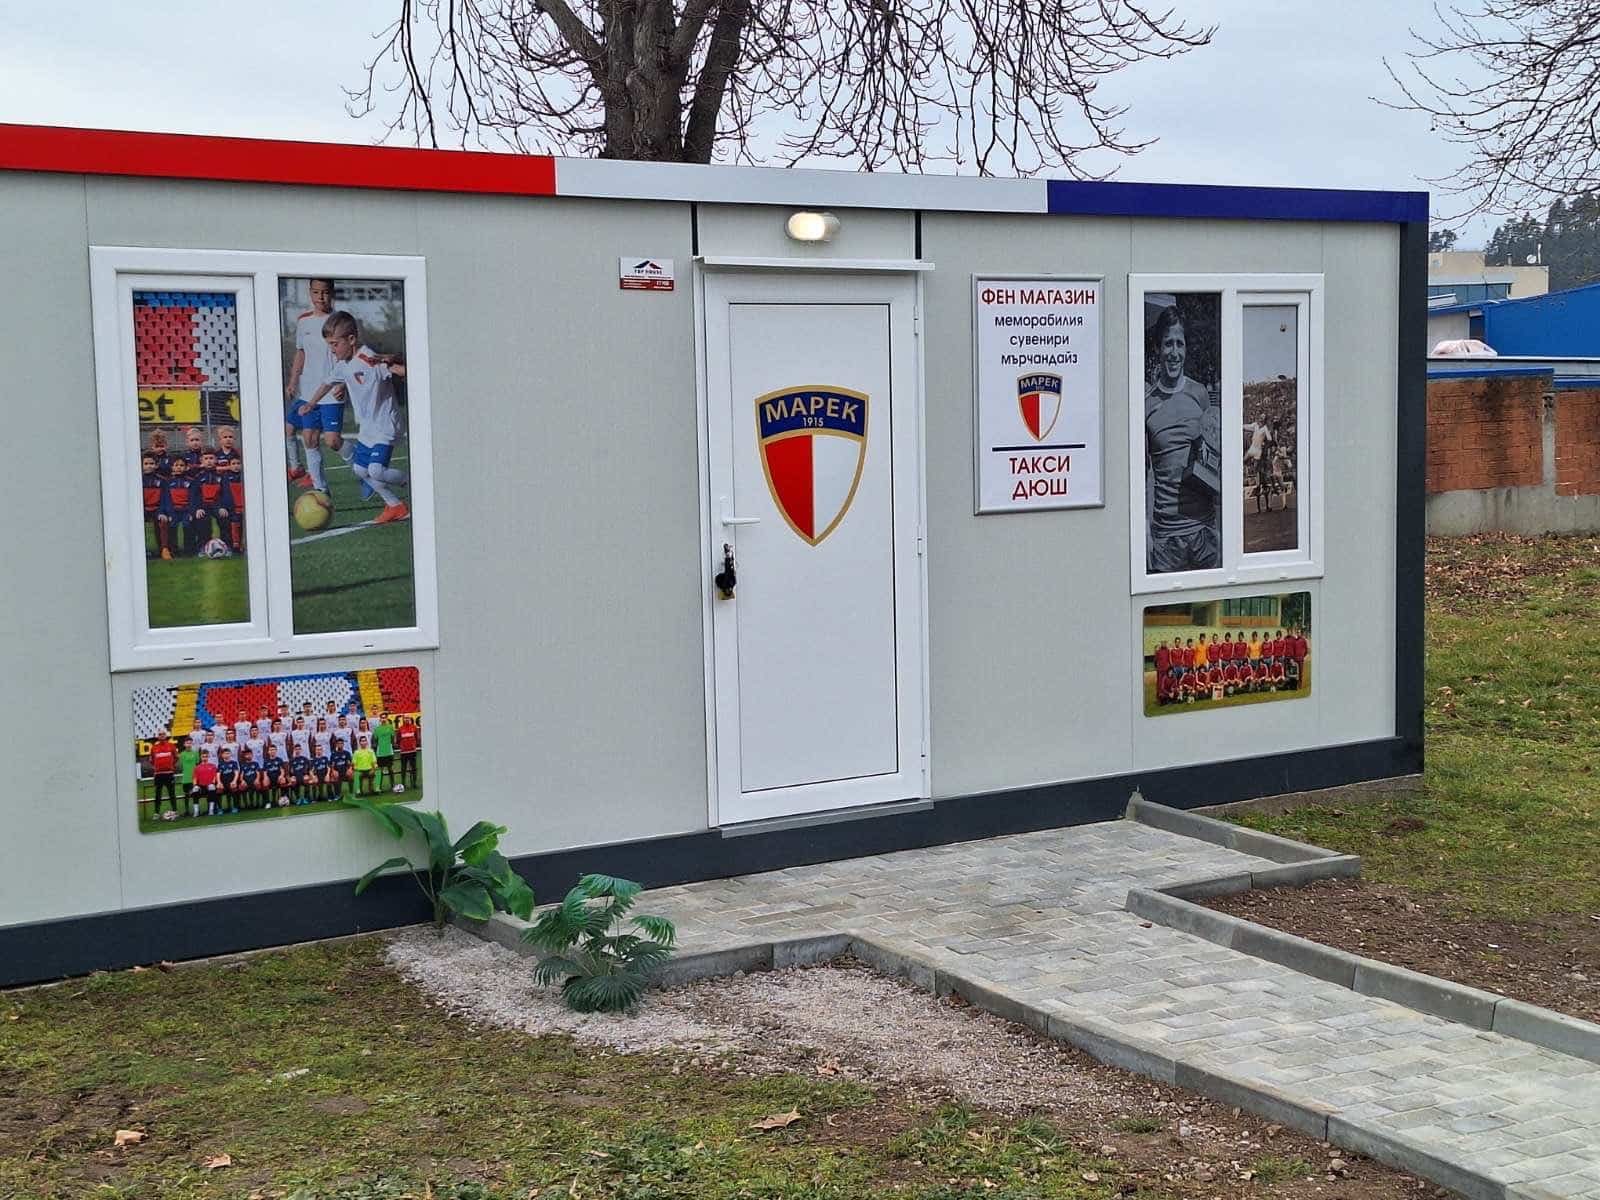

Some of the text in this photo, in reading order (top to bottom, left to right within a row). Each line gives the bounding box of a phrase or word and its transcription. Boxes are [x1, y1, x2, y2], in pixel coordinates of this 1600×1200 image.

[981, 288, 1095, 305] ФЕН МАГАЗИН
[994, 314, 1083, 329] меморабилия
[1009, 335, 1070, 347] сувенири
[1001, 351, 1078, 367] мърчандайз
[1020, 376, 1059, 388] МАРЕК
[765, 397, 858, 423] МАРЕК
[803, 417, 824, 427] 1915
[1009, 455, 1070, 474] ТАКСИ
[1012, 478, 1067, 500] ДЮШ
